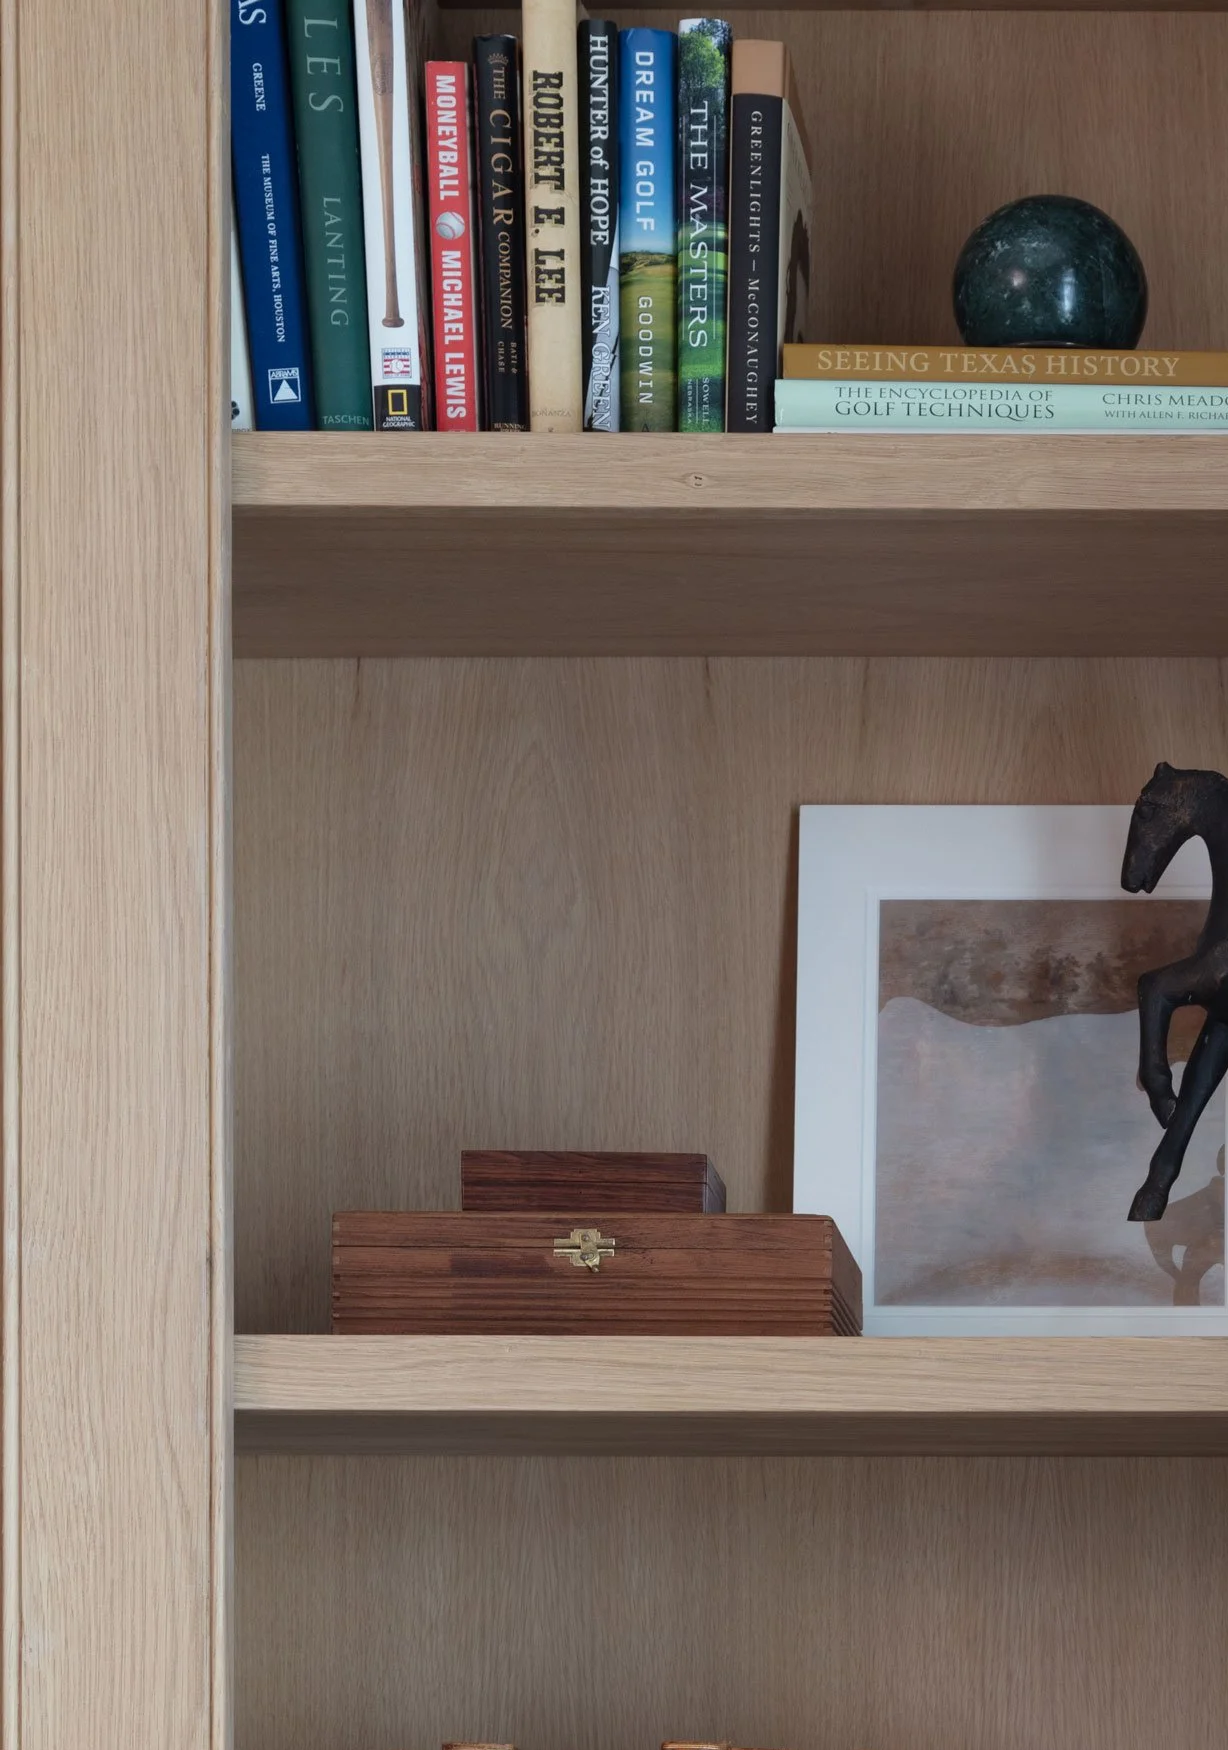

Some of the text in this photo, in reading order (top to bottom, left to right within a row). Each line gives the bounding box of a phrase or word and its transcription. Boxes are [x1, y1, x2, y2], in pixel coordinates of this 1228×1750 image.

[252, 63, 266, 111] GREENE
[304, 16, 344, 112] LES
[436, 75, 459, 201] MONEYBALL
[532, 70, 566, 304] ROBERT E. LEE
[589, 34, 610, 246] HUNTER of HOPE
[635, 51, 655, 231] DREAM GOLF
[489, 67, 514, 330] THE CIGAR COMPANION
[688, 101, 709, 348] THE MASTERS
[323, 197, 349, 326] LANTING
[745, 110, 763, 424] GREENLIGHTS McCONAUGHEY
[271, 369, 298, 379] ABRAMS
[442, 250, 467, 419] MICHAEL LEWIS
[497, 341, 505, 373] CHASE
[592, 285, 611, 429] KEN GREEN
[638, 296, 653, 404] GOODWIN
[817, 350, 1181, 378] SEEING TEXAS HISTORY
[322, 415, 370, 426] TASCHEN
[835, 386, 1053, 402] THE ENCYCLOPEDIA OF
[835, 401, 1055, 422] GOLF TECHNIQUES
[1102, 393, 1163, 406] CHRIS
[1104, 410, 1136, 420] WITH
[1139, 410, 1174, 420] ALLEN
[1176, 411, 1186, 420] F.
